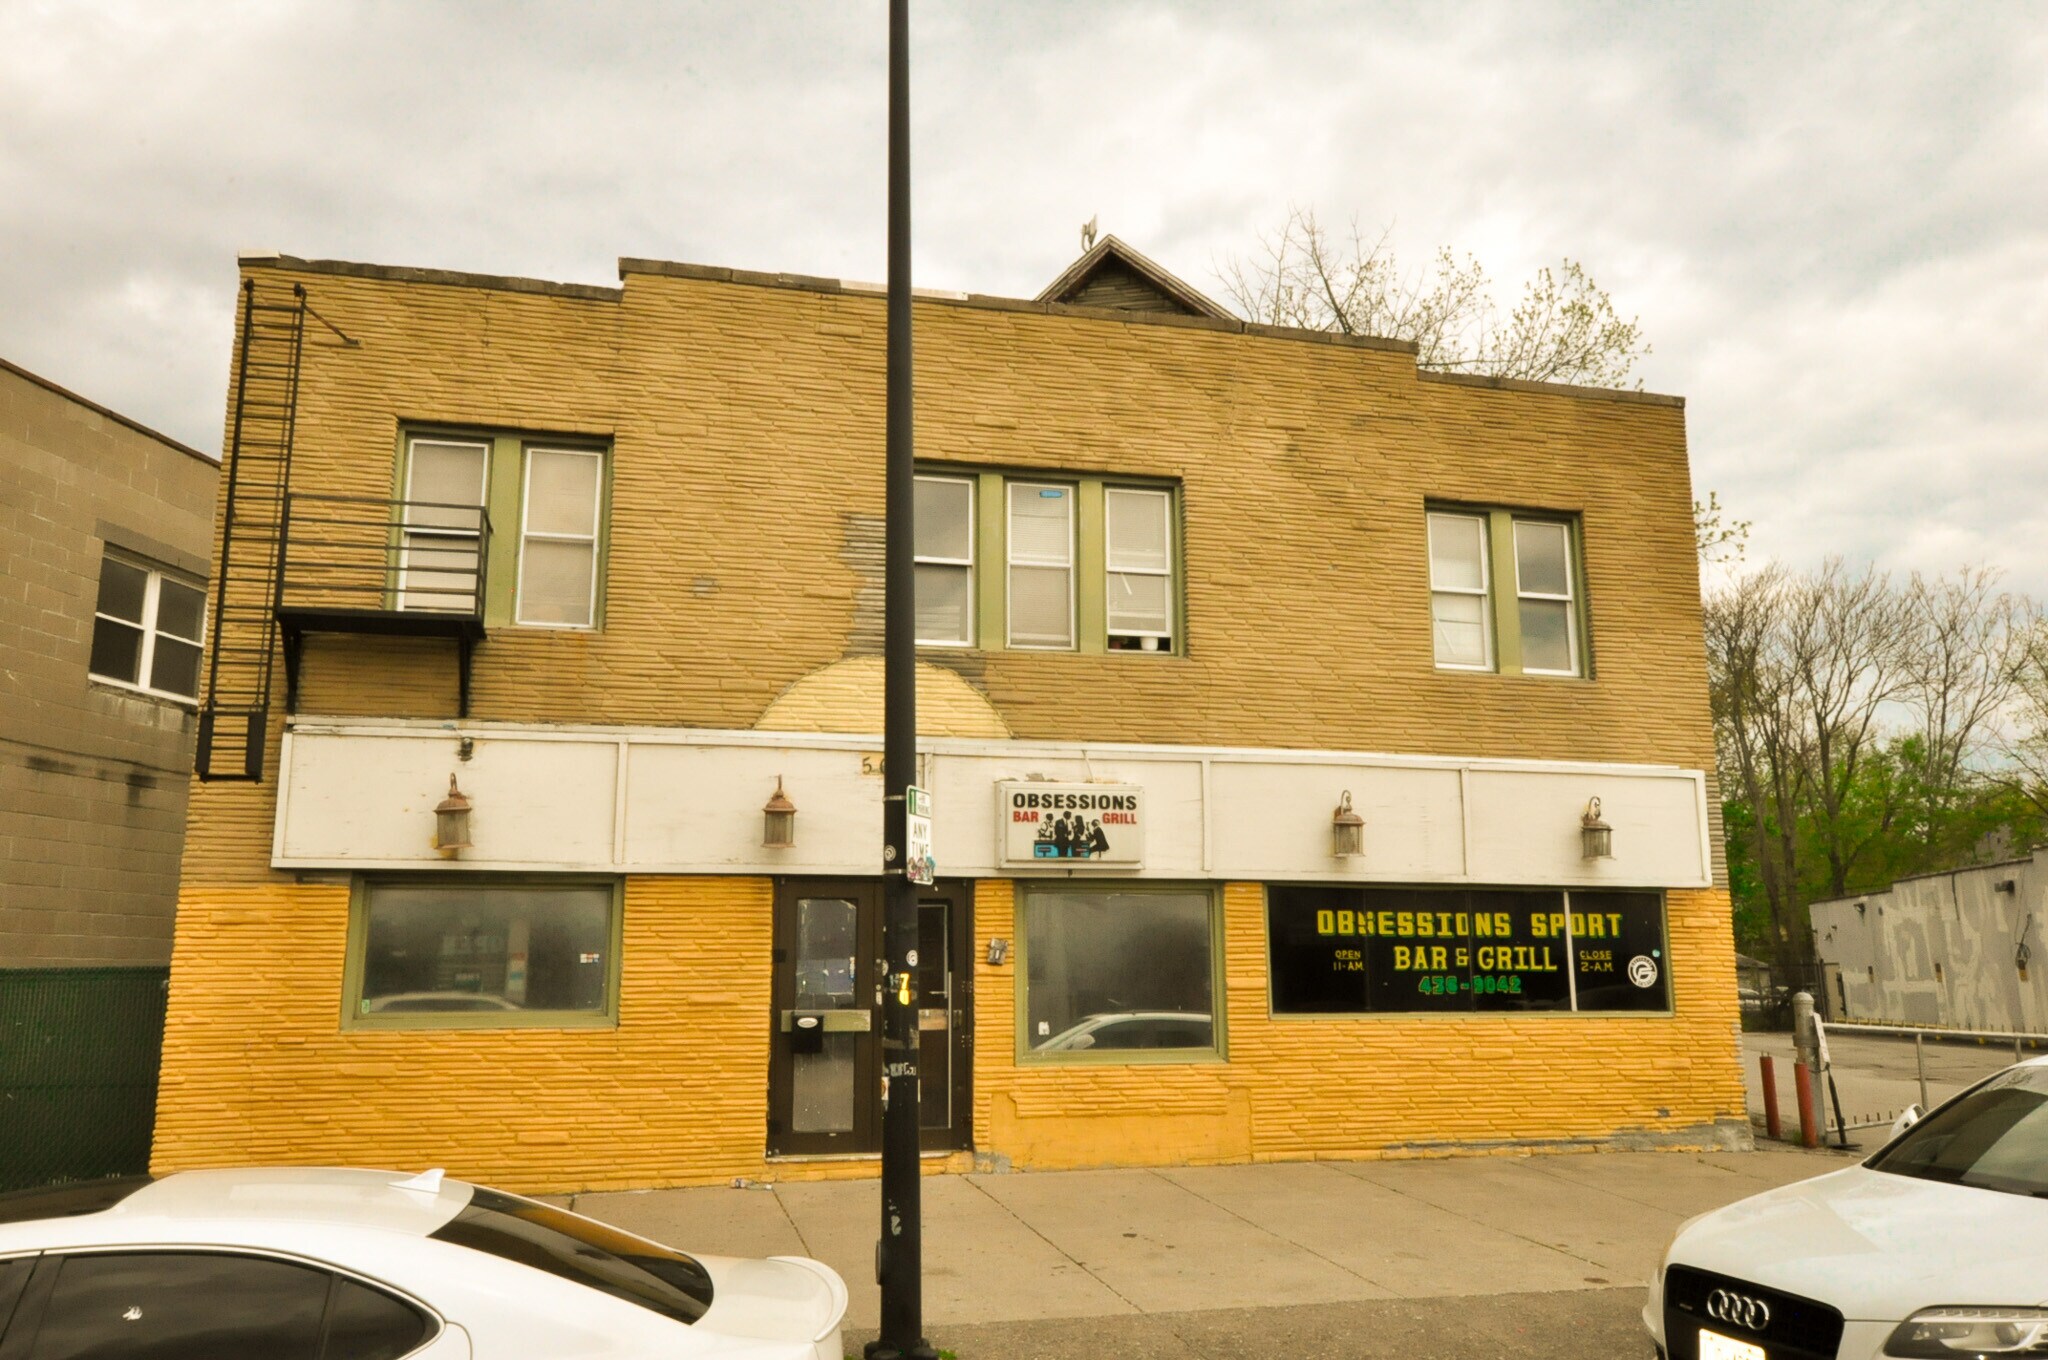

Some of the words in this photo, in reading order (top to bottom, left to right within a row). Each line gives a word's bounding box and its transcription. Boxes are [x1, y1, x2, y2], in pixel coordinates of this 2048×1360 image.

[1013, 793, 1137, 810] OBSESSIONS
[1013, 811, 1039, 822] BAR
[1102, 812, 1137, 824] GRILL
[913, 822, 928, 840] ANY
[1531, 913, 1622, 938] SPORT
[1335, 950, 1361, 959] OPEN
[1394, 946, 1448, 970] BAR
[1456, 948, 1469, 966] &
[1478, 946, 1558, 971] GRILL
[1580, 950, 1612, 960] CLOSE
